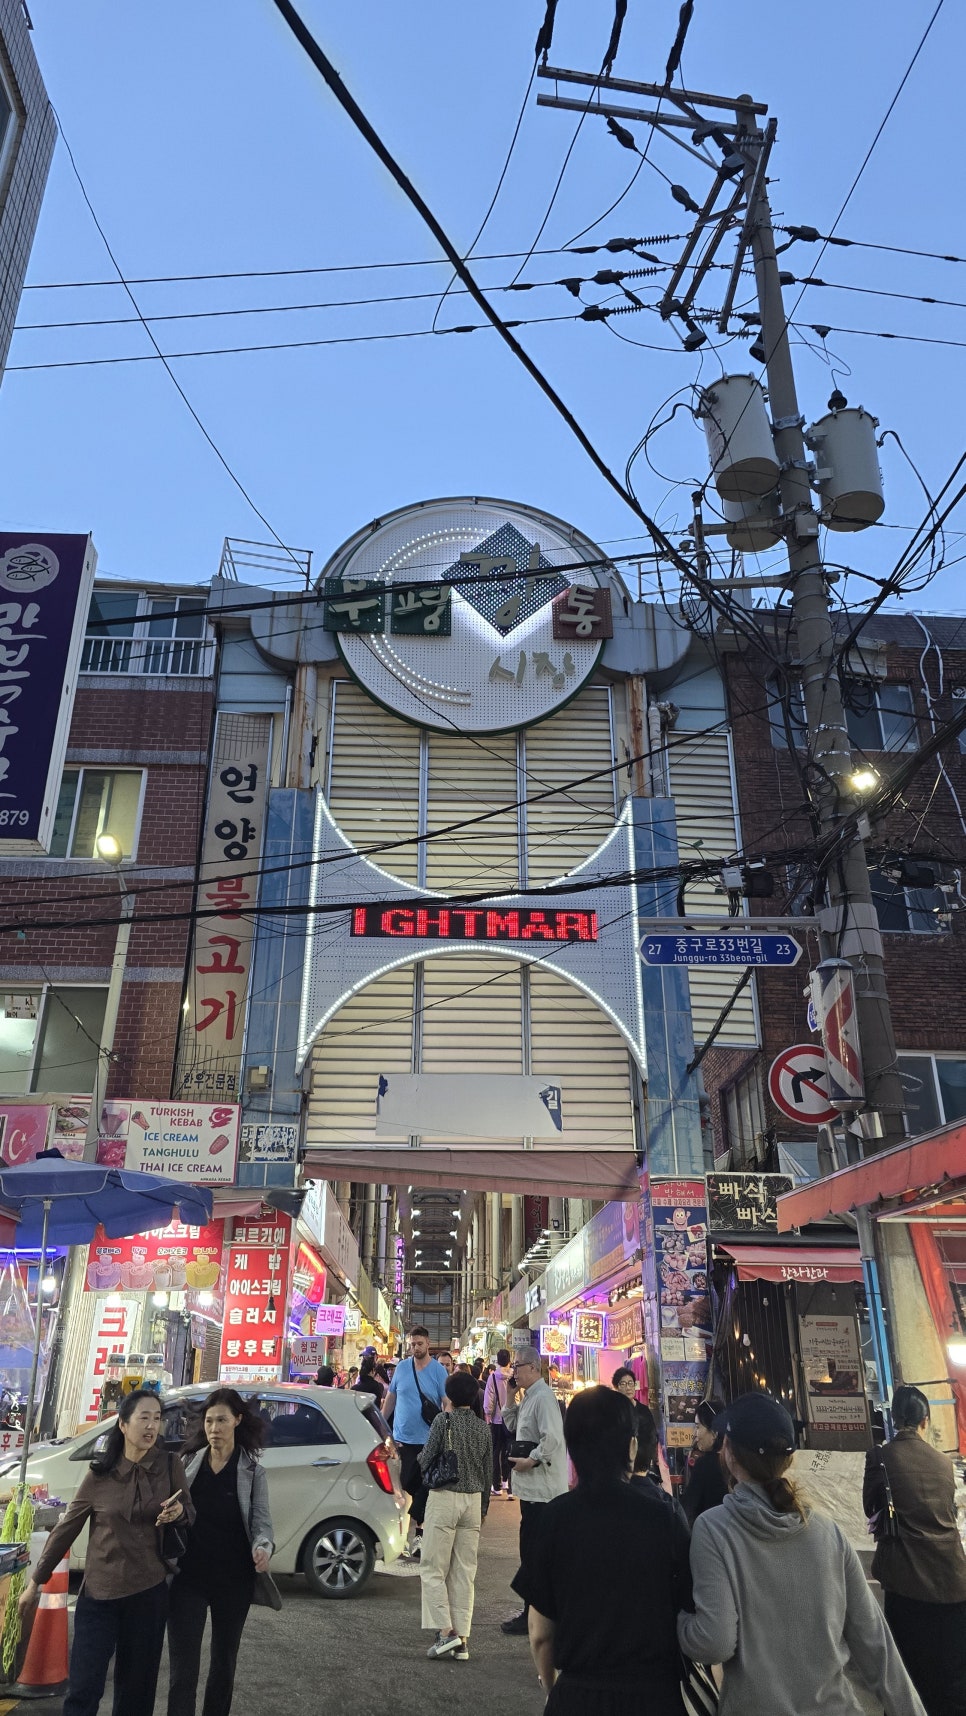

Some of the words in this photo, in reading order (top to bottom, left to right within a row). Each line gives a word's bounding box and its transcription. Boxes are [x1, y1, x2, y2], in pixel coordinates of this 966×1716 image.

[489, 650, 576, 688] 시장
[354, 907, 597, 940] IGHTMAR
[648, 944, 662, 955] 27
[675, 938, 763, 954] 중구로33번길
[775, 943, 791, 955] 23
[673, 953, 717, 963] Junggu-ro
[719, 953, 768, 963] 33beon-gil
[150, 1107, 195, 1117] TURKISH
[169, 1118, 203, 1127] KEBAB
[144, 1132, 160, 1141] ICE
[163, 1133, 199, 1142] CREAM
[143, 1147, 200, 1158] TANGHULU
[140, 1162, 165, 1172] THAI
[168, 1164, 184, 1172] ICE
[186, 1164, 223, 1173] CREAM
[718, 1181, 767, 1204] 빠삭
[229, 1279, 282, 1296] 아이스크림
[226, 1339, 277, 1358] 탕후루
[293, 1355, 324, 1367] 아이스크림
